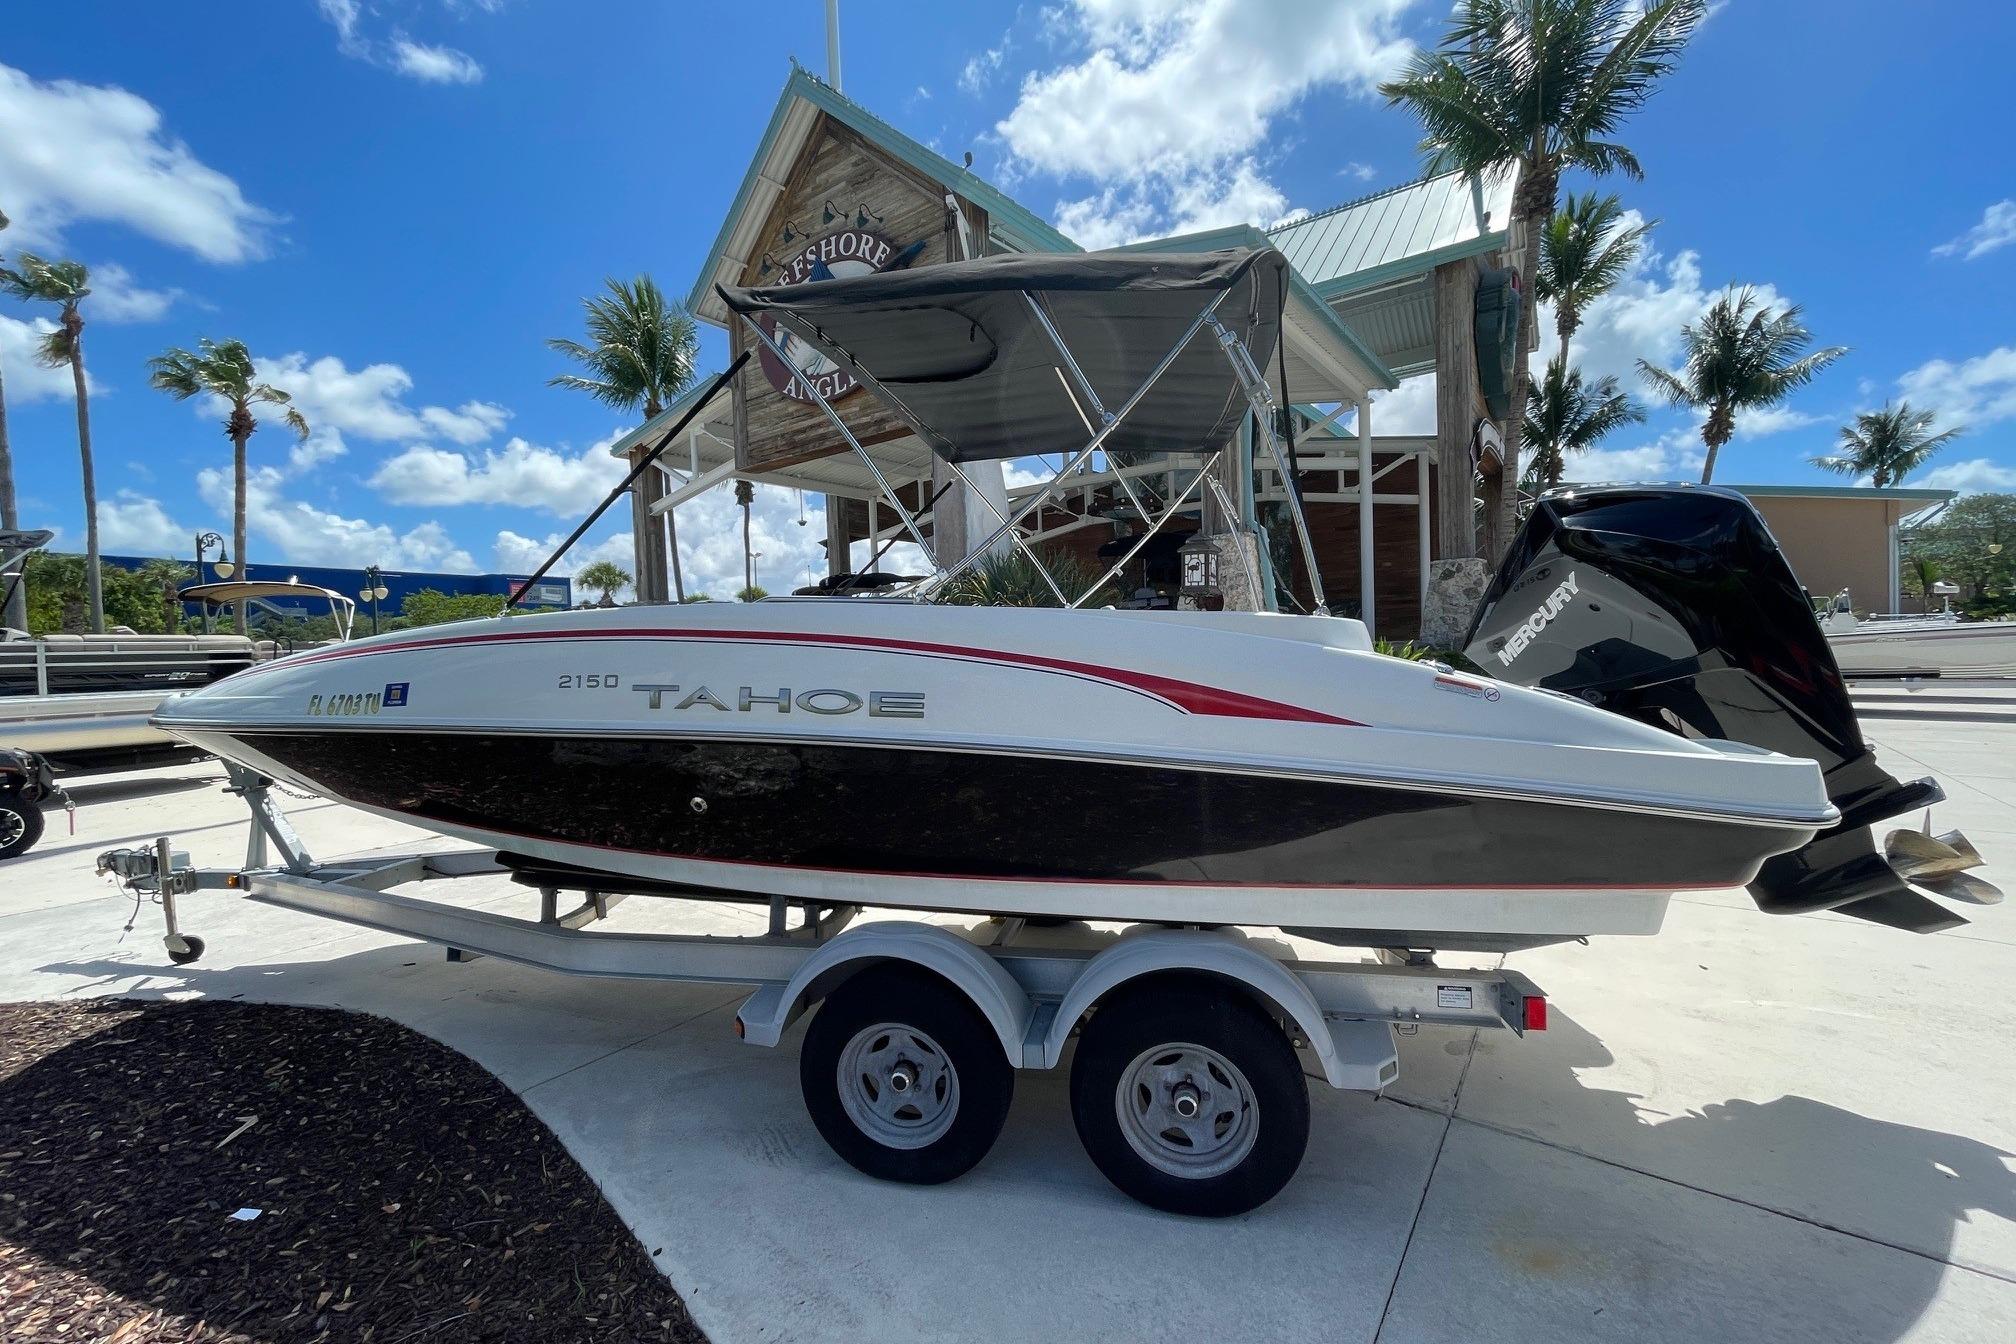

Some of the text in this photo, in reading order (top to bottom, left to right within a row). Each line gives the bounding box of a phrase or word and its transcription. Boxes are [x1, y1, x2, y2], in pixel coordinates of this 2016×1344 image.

[778, 232, 890, 286] FFSHORE
[782, 371, 858, 400] ANGL
[1498, 571, 1579, 667] MERCURY
[559, 674, 619, 689] 2150
[308, 692, 382, 716] FL 6703 TU
[632, 684, 925, 718] TAHOE
